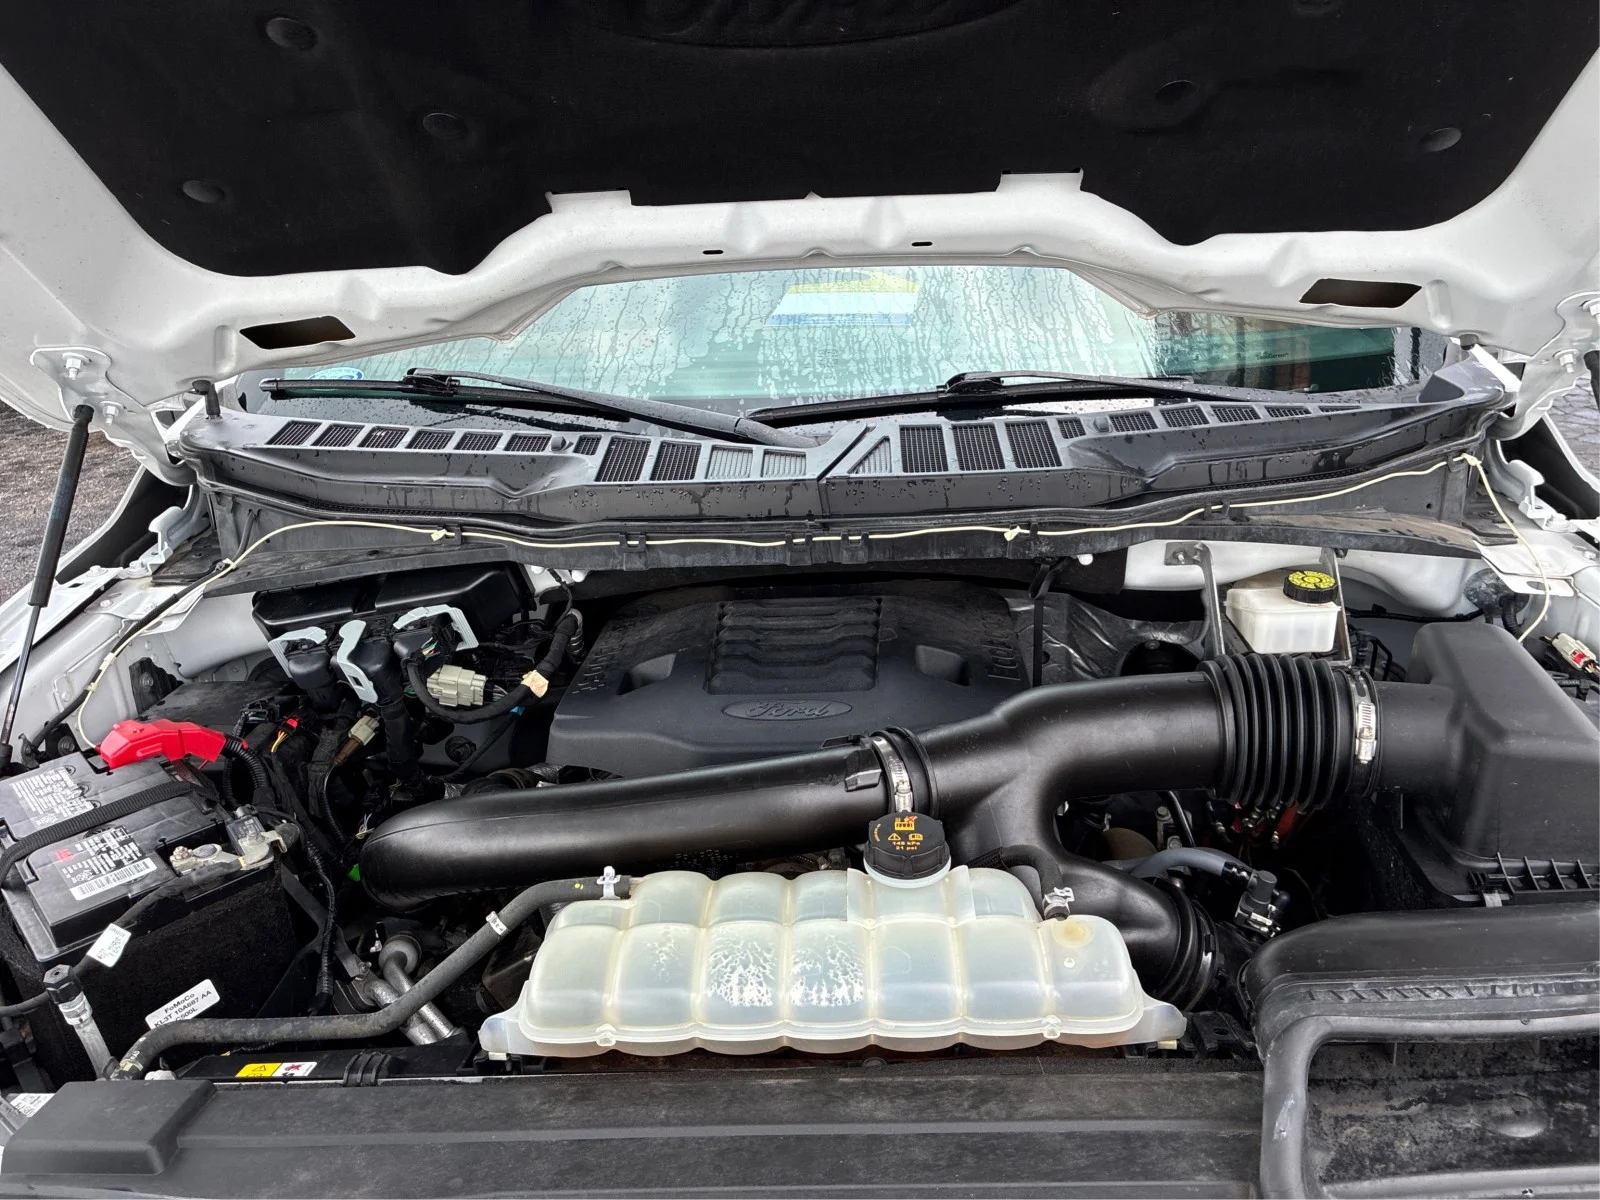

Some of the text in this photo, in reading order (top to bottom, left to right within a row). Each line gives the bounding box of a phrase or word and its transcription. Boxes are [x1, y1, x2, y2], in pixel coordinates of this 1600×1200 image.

[747, 702, 832, 718] Ford
[154, 1013, 173, 1027] KL3T
[201, 990, 212, 1000] AA
[164, 993, 195, 1013] FoMoCo
